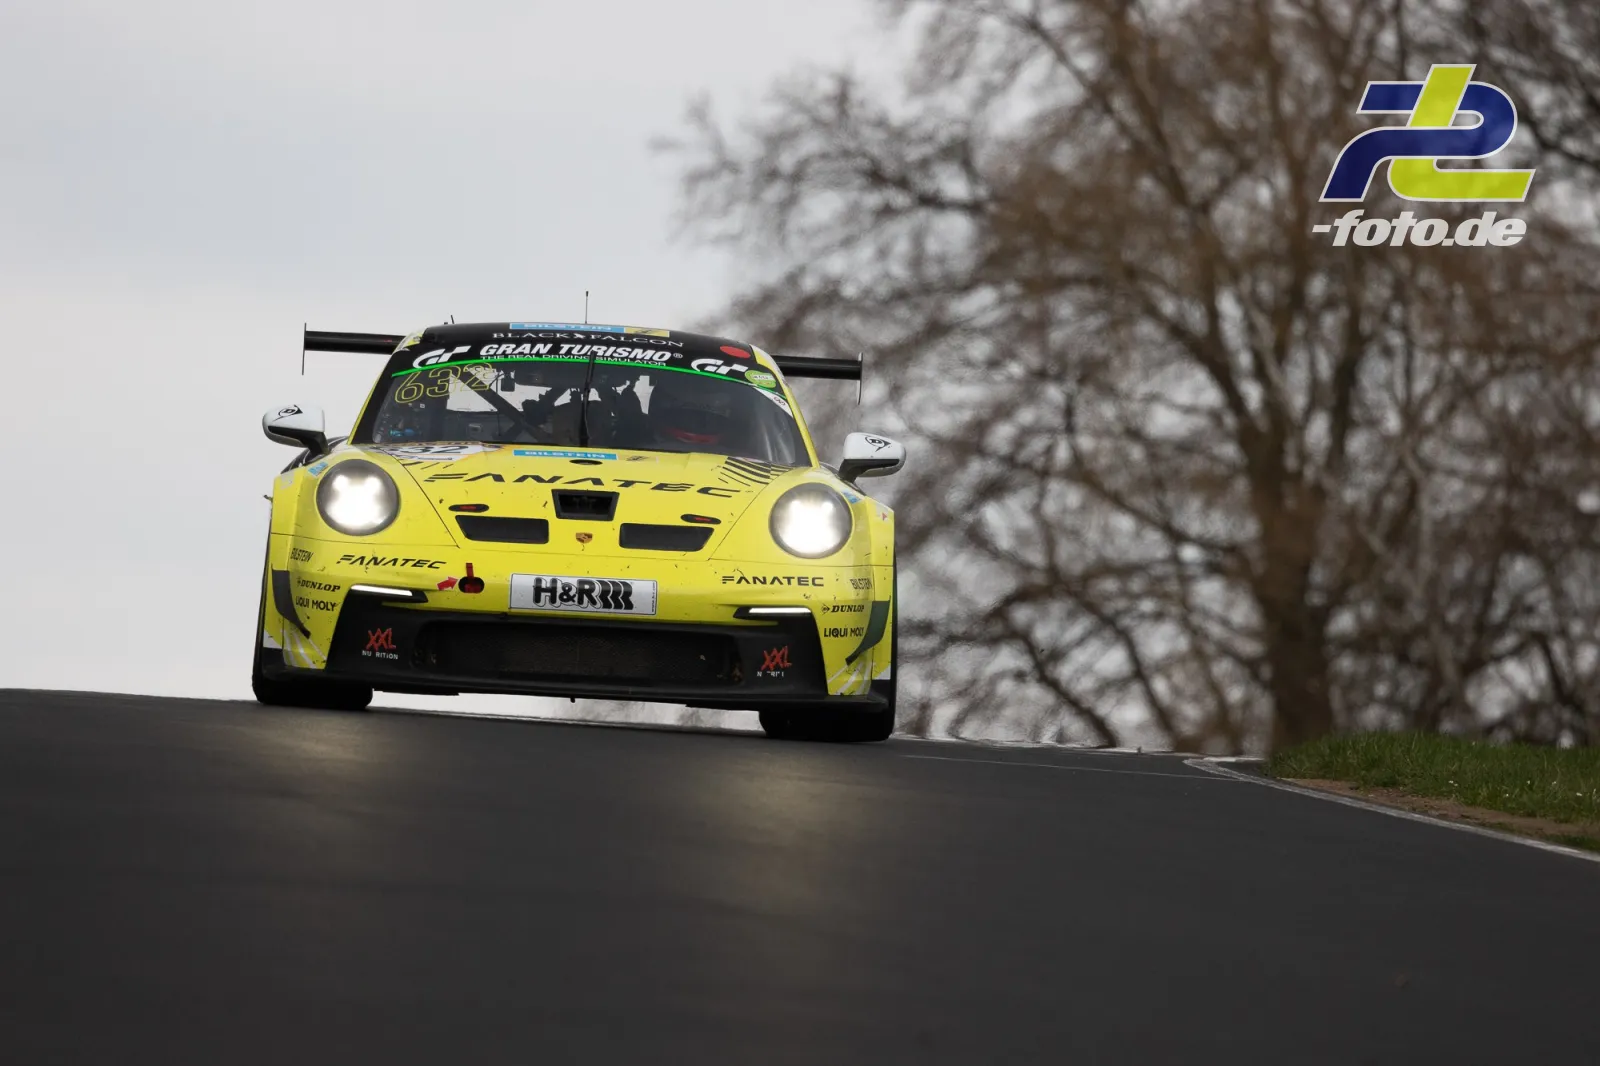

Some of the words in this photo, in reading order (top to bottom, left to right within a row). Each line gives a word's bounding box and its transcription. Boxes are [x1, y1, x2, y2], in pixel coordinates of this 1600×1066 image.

[590, 334, 684, 348] FALCON
[480, 343, 553, 356] GRAN
[596, 356, 666, 367] SIMULATOR
[395, 362, 492, 404] 632
[525, 451, 606, 459] BILSTEIN
[424, 473, 741, 498] FANATEC
[336, 554, 447, 569] FANATEC
[300, 579, 341, 592] DUNLOP
[722, 575, 825, 587] FANATEC
[311, 599, 337, 612] MOLY
[831, 604, 865, 613] DUNLOP
[366, 627, 396, 650] XXL
[824, 627, 848, 638] LIQUI
[361, 650, 399, 660] NURITION
[761, 646, 793, 670] XXL
